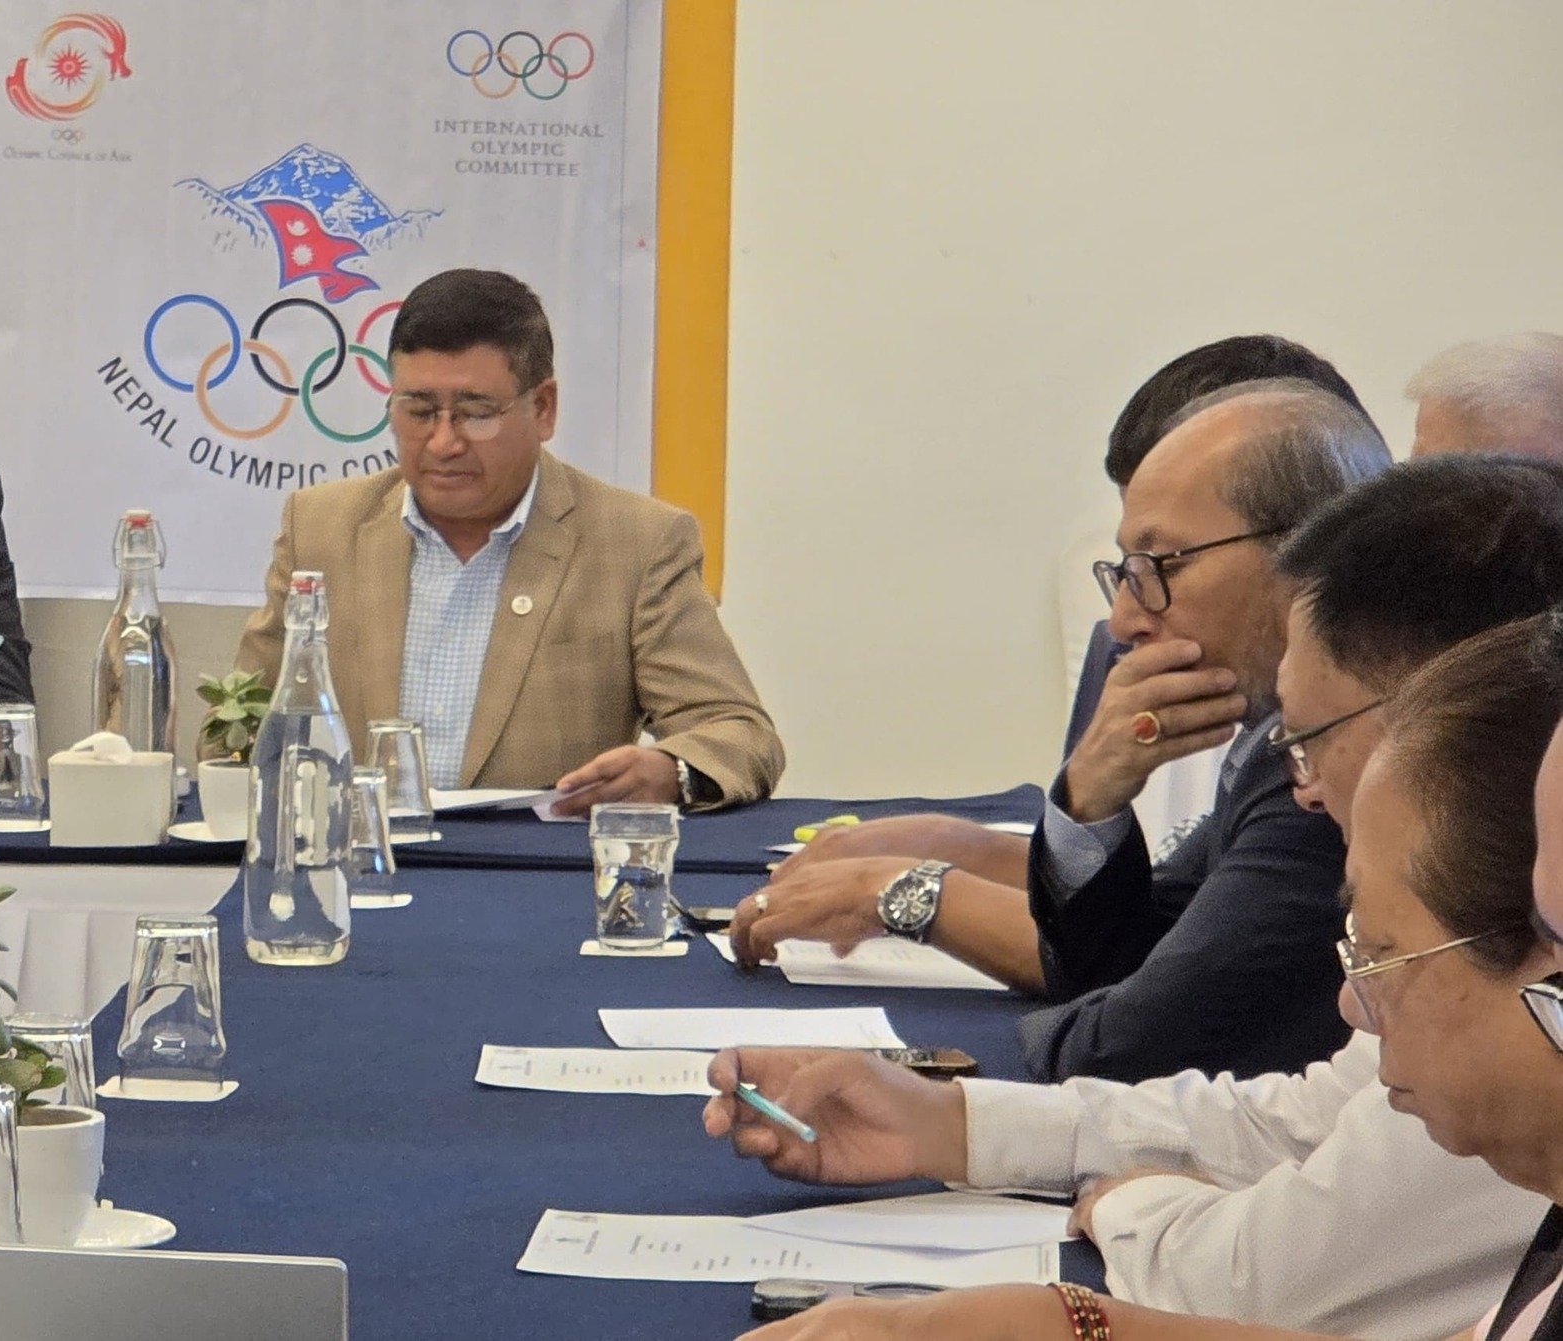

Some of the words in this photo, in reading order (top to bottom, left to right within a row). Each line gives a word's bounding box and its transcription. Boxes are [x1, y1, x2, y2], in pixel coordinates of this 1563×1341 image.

[434, 120, 605, 138] INTERNATIONAL
[470, 140, 566, 157] OLYMPIC
[454, 160, 581, 177] COMMITTEE
[97, 356, 178, 448] NEPAL
[189, 436, 327, 490] OLYMPIC
